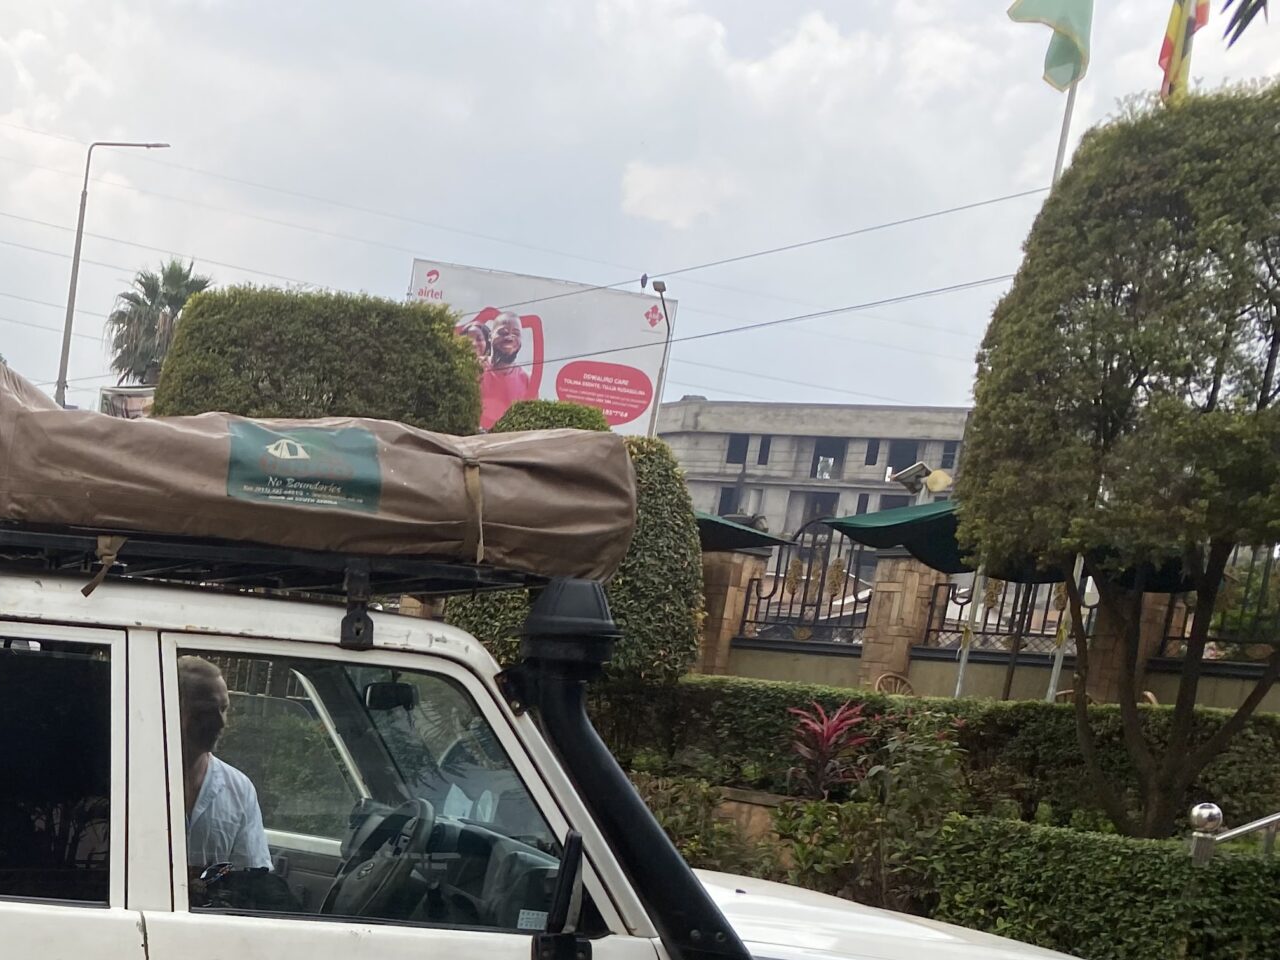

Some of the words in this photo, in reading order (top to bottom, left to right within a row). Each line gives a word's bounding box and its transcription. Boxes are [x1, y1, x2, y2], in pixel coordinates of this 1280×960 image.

[418, 286, 443, 300] airtel
[267, 476, 282, 488] No
[286, 478, 342, 494] Boundaries
